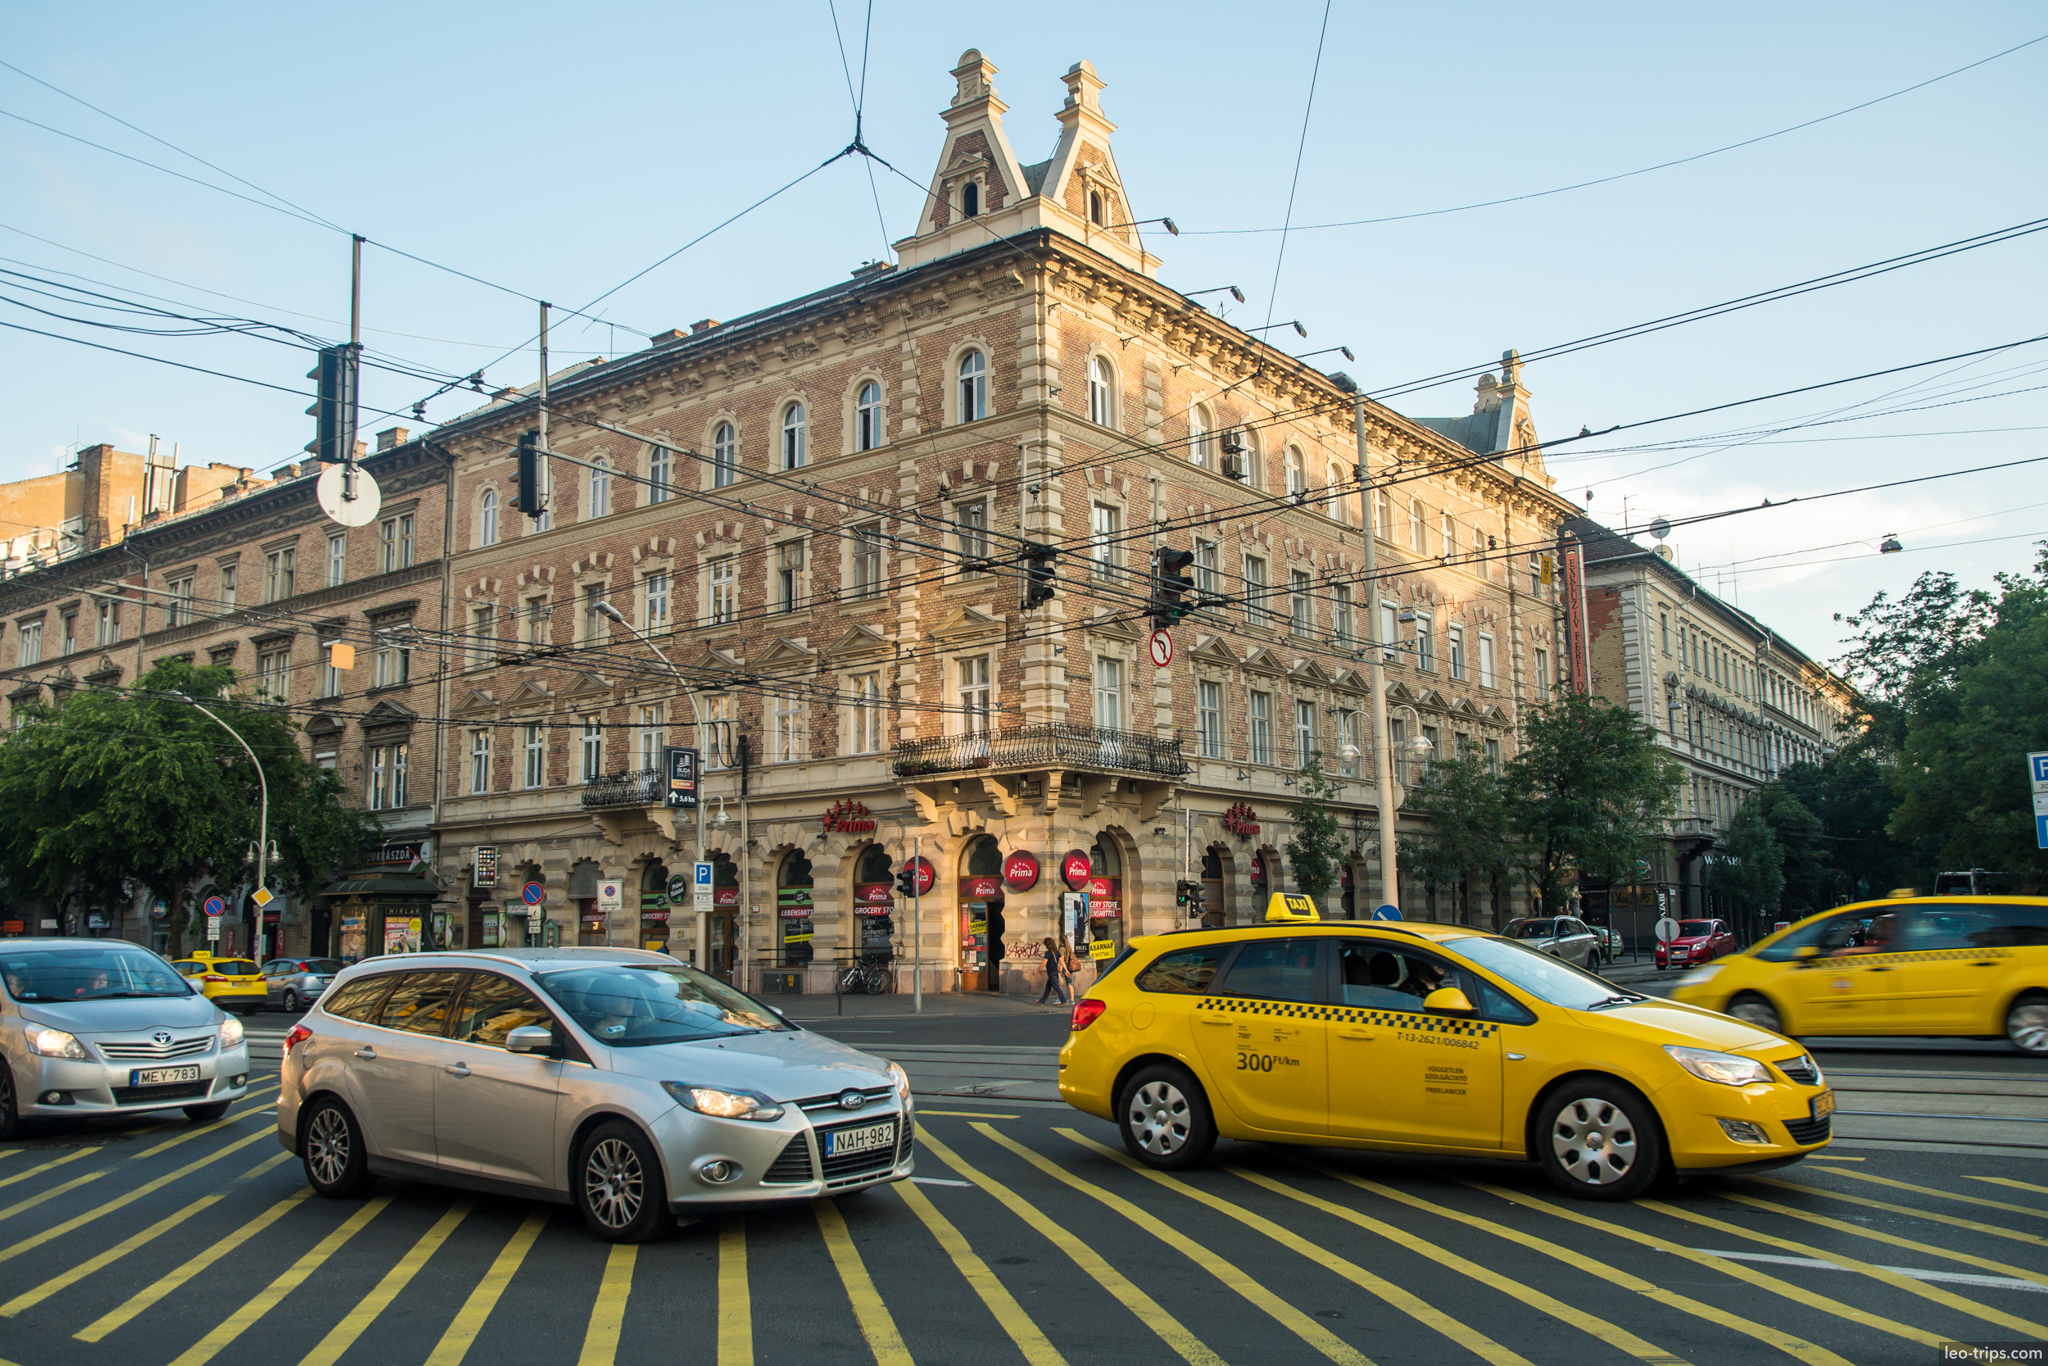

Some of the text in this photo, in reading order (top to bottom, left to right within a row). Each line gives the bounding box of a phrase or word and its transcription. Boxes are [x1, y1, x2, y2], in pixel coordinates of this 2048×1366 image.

[699, 867, 708, 882] P
[1286, 898, 1308, 910] TAXI
[780, 908, 814, 917] LEBENSMITT
[882, 906, 894, 914] STO
[641, 912, 664, 920] GROCERY
[1090, 942, 1114, 951] ASÁRNAP
[1237, 1052, 1300, 1073] 300 Ft/km
[141, 1068, 196, 1084] MEY-783
[1425, 1086, 1467, 1096] FREELANCER
[848, 1096, 862, 1105] Ford
[836, 1124, 892, 1152] NAH-982
